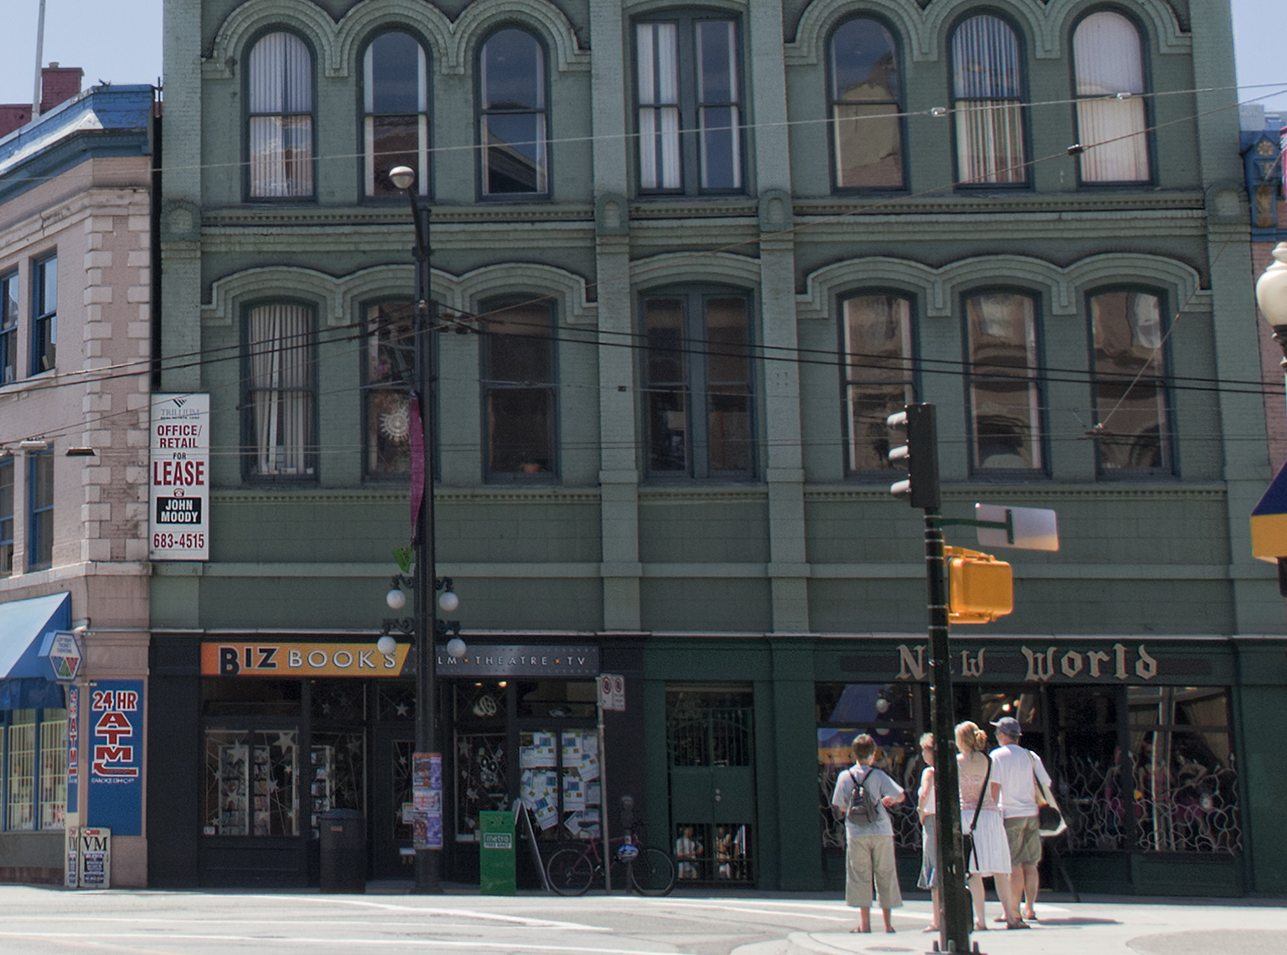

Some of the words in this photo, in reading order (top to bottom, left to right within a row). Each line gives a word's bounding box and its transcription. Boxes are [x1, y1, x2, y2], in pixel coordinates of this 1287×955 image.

[157, 424, 202, 437] OFFICE/
[159, 437, 199, 448] RETAIL
[173, 451, 187, 460] FOR
[153, 460, 205, 486] LEASE
[165, 499, 193, 510] JOHN
[160, 510, 199, 523] MOODY
[153, 533, 205, 548] 683-4515
[218, 646, 280, 676] BIZ
[288, 649, 397, 670] BOOKS
[437, 656, 458, 665] LM
[475, 656, 548, 666] THEATRE
[567, 656, 586, 666] TV
[896, 644, 986, 680] Nw
[1021, 643, 1158, 682] World
[92, 690, 113, 711] 24
[116, 690, 138, 711] HR
[95, 711, 133, 763] ATM
[83, 836, 108, 851] VM
